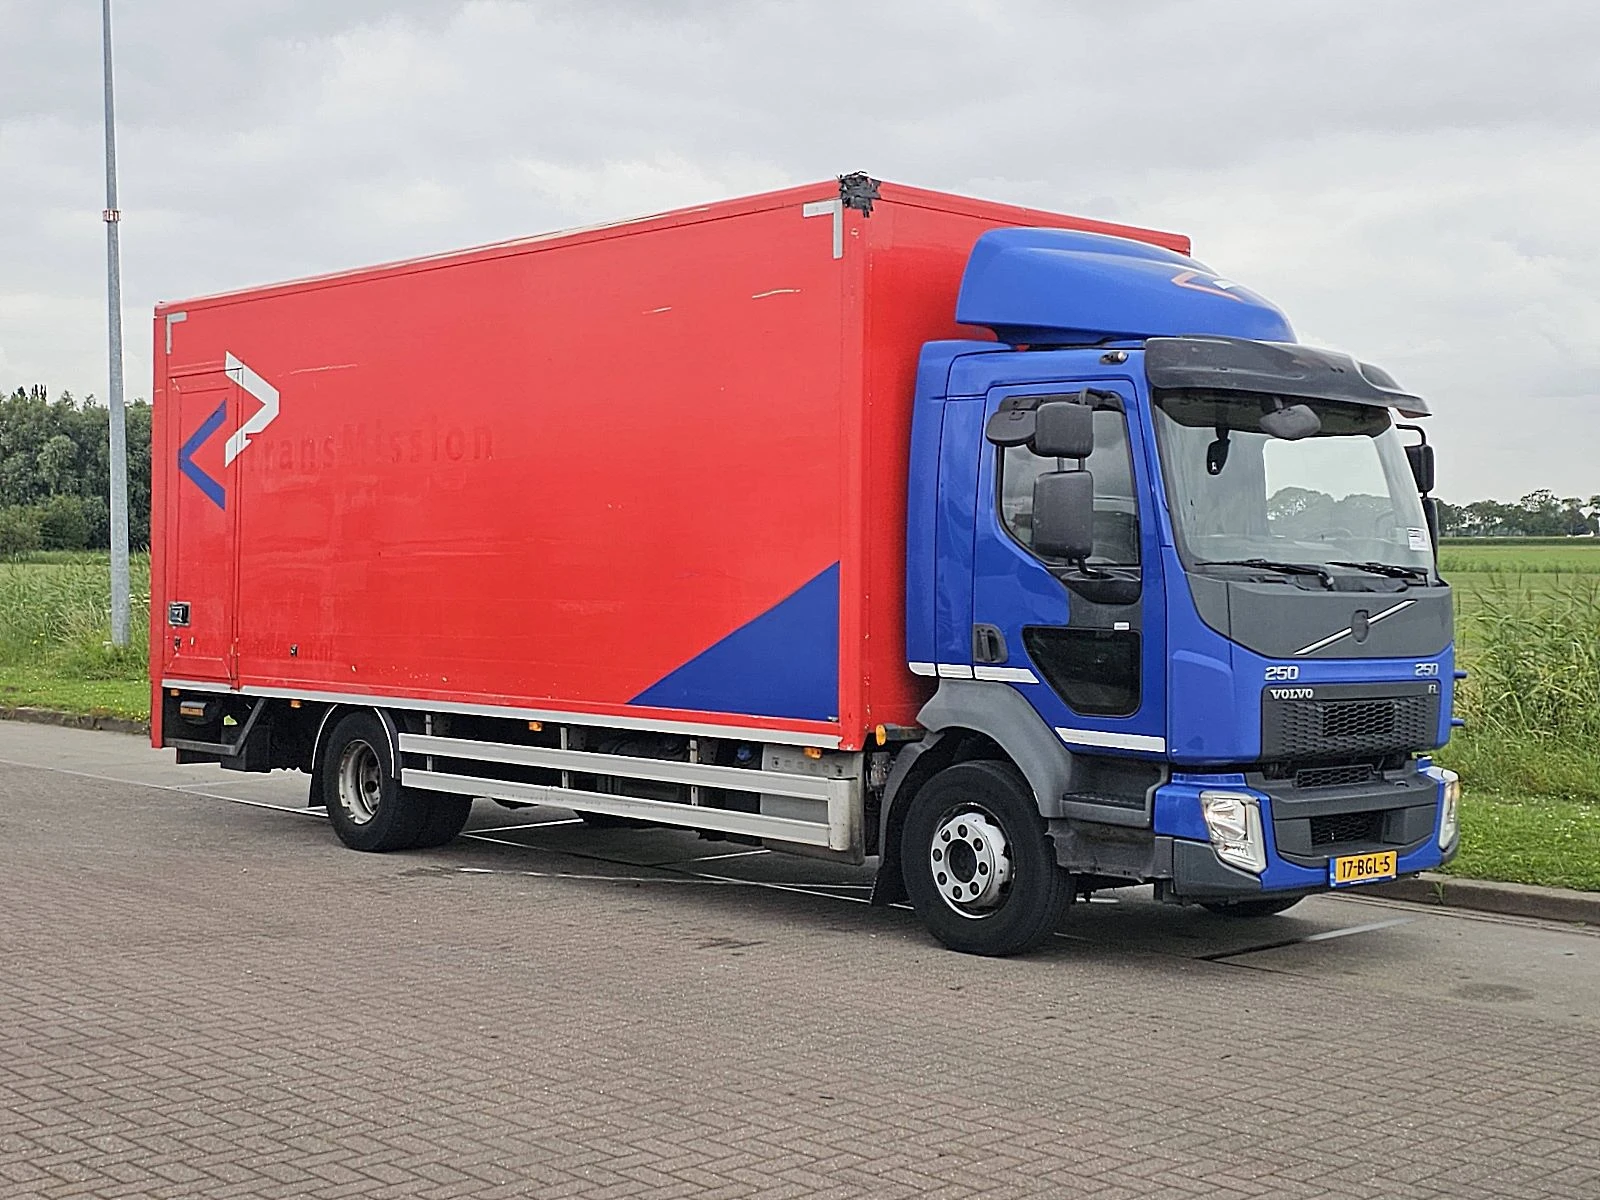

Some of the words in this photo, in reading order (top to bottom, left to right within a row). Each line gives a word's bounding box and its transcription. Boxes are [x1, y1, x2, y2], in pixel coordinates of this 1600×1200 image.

[1264, 666, 1299, 681] 250
[1414, 663, 1439, 677] 250
[1269, 688, 1314, 700] VOLVO
